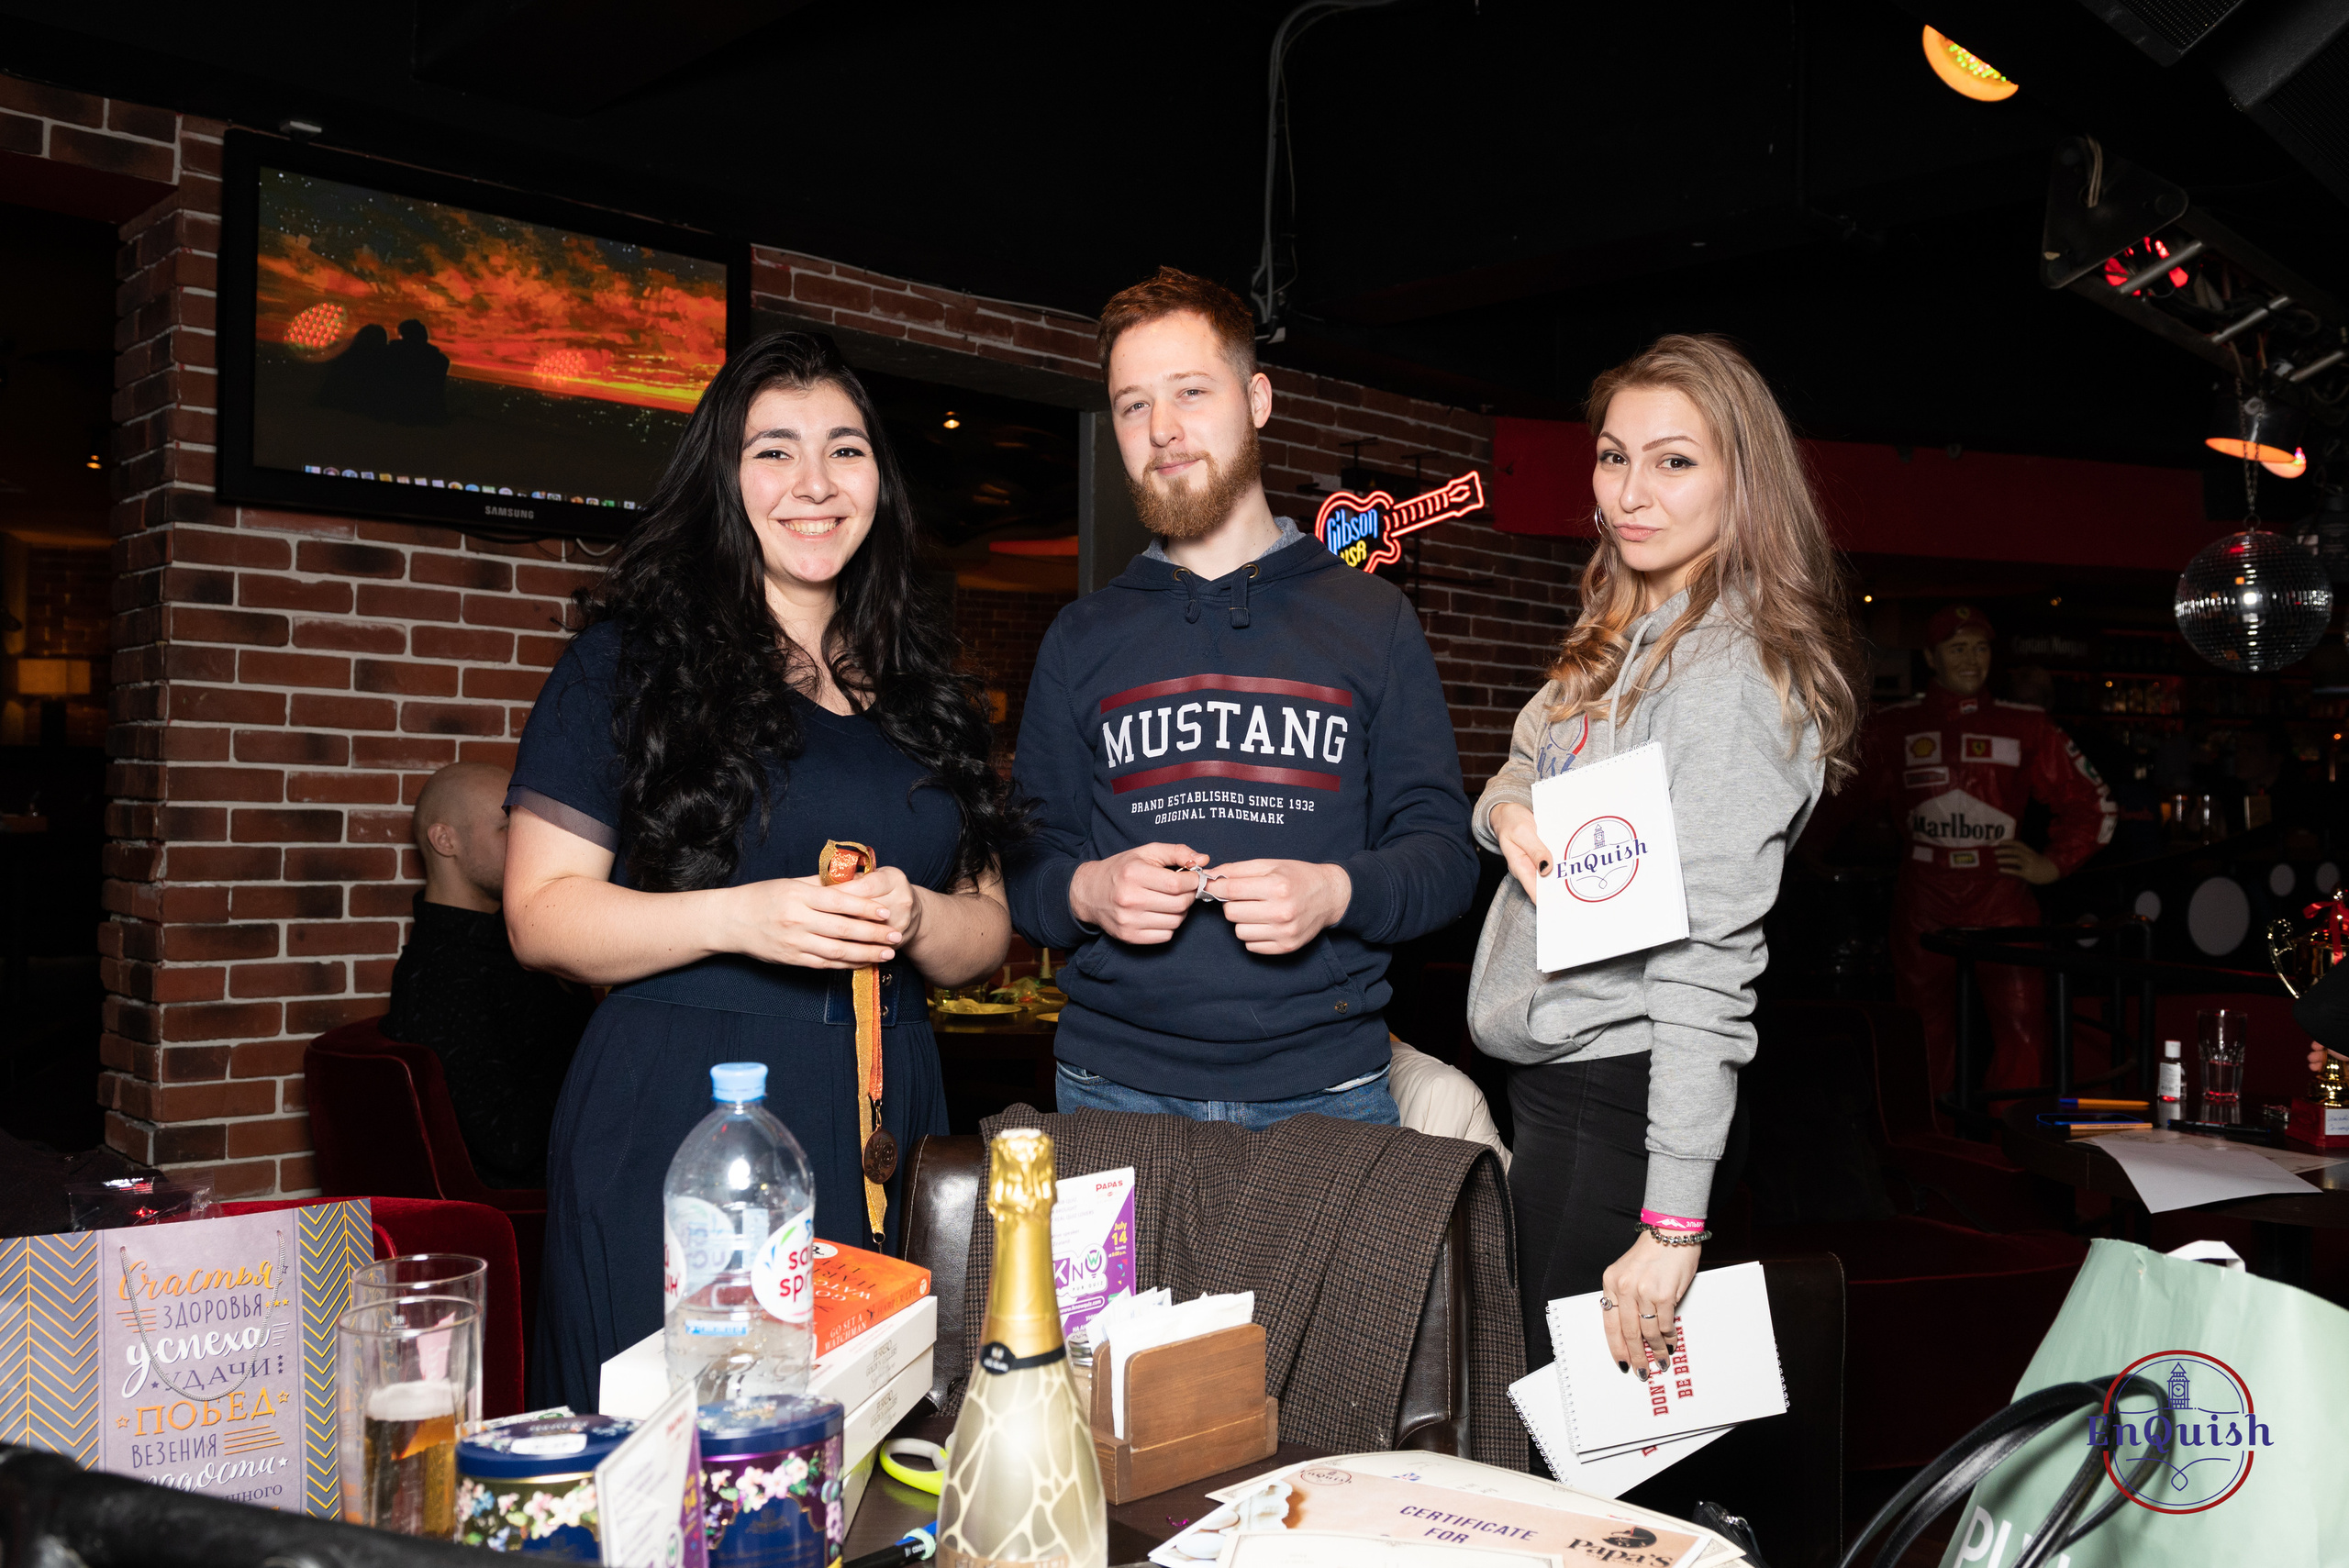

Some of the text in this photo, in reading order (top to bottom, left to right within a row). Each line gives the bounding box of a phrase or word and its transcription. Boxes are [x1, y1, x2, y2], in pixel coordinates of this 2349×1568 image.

[484, 506, 535, 519] SAMSUNG
[1327, 508, 1378, 556] Gibson
[1340, 539, 1367, 568] USA
[1102, 701, 1349, 768] MUSTANG
[1131, 791, 1315, 814] BRAND ESTABLISHED SINCE 1932
[1154, 807, 1285, 825] ORIGINAL TRADEMARK
[1914, 813, 2005, 840] Marlboro
[1557, 840, 1648, 878] EnQuish
[1112, 1231, 1128, 1245] 14
[1114, 1220, 1128, 1231] July
[163, 1294, 262, 1329] ЗДОРОВЬЯ
[825, 1320, 867, 1351] WATCHMAN
[829, 1325, 841, 1339] GO
[844, 1316, 855, 1329] SET
[121, 1327, 273, 1398] успеха
[165, 1358, 271, 1392] УДАЧИ
[1676, 1378, 1694, 1399] BE
[134, 1387, 276, 1437] ПОБЕД
[131, 1434, 217, 1469] ВЕЗЕНИЯ
[1399, 1506, 1539, 1541] CERTIFICATE
[1423, 1527, 1470, 1544] FOR
[1565, 1538, 1673, 1567] Papa's
